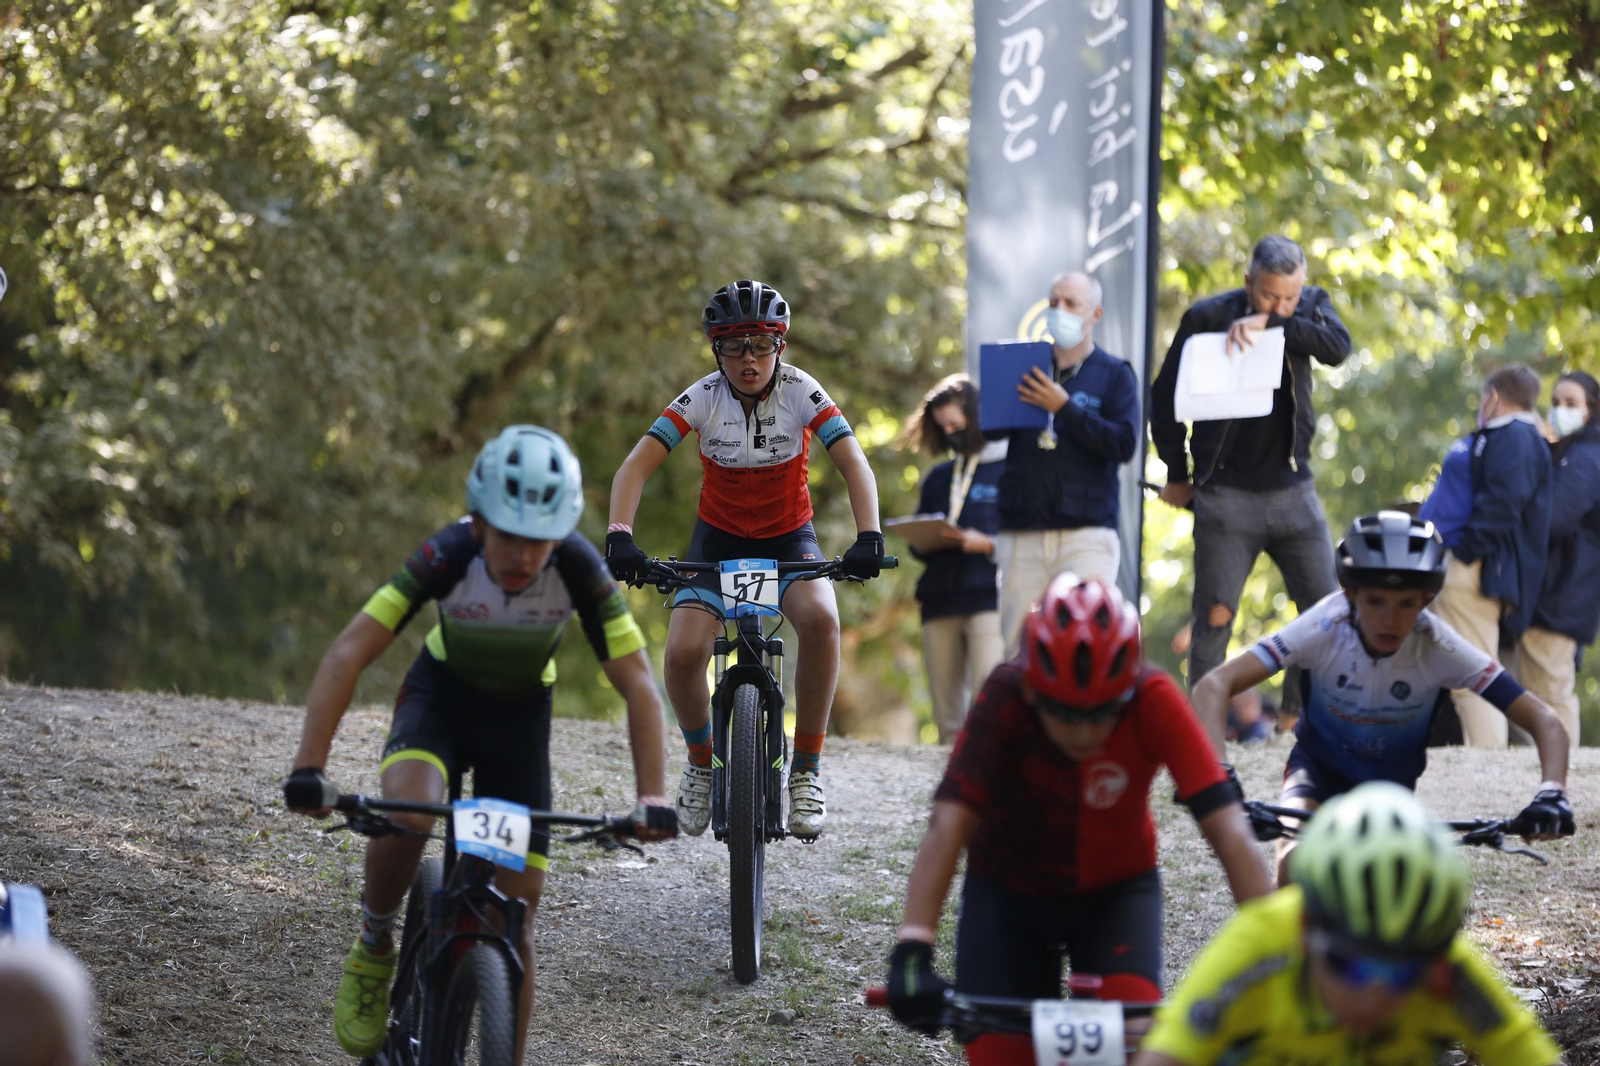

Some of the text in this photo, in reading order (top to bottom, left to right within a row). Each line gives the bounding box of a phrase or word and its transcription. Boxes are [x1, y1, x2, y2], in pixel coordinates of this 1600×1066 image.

[718, 455, 738, 463] DAFER
[733, 572, 766, 603] 57
[790, 776, 811, 785] LUCK
[472, 811, 514, 848] 34
[1053, 1022, 1104, 1058] 99
